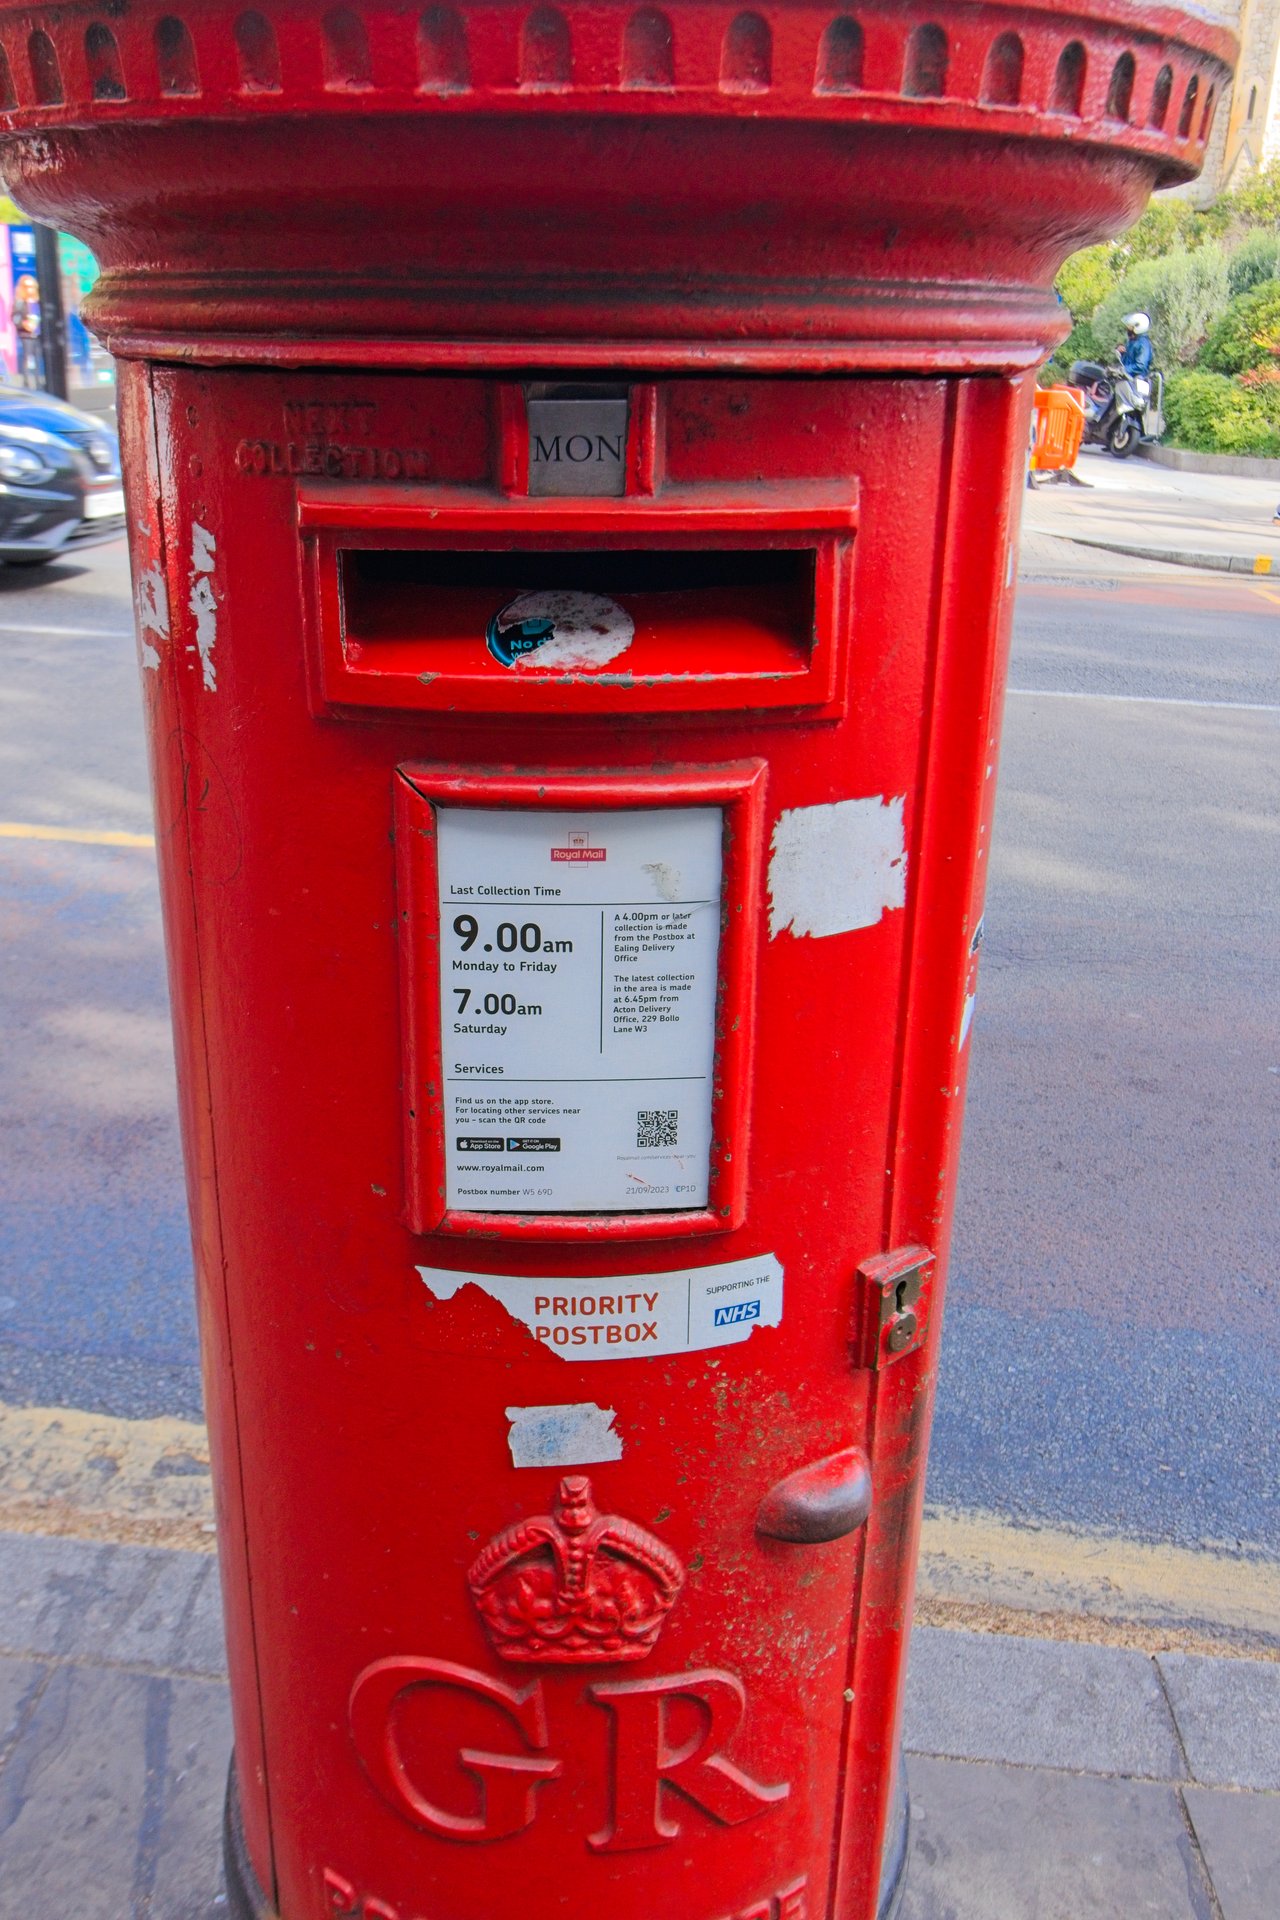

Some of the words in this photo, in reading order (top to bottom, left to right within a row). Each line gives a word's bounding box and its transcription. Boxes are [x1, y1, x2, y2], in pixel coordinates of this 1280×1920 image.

[533, 435, 622, 462] MON
[235, 439, 430, 477] COLLECTION
[510, 640, 533, 650] No
[553, 850, 580, 860] Royal
[582, 851, 603, 859] Mail
[450, 884, 474, 895] Last
[477, 885, 530, 896] Collection
[533, 886, 561, 896] Time
[622, 912, 658, 923] 4.00pm
[672, 912, 692, 921] later
[614, 923, 653, 932] collection
[655, 923, 663, 931] is
[665, 922, 688, 931] made
[452, 914, 573, 953] 9.00am
[614, 934, 634, 942] from
[636, 934, 650, 942] the
[652, 933, 685, 941] Postbox
[614, 944, 640, 953] Ealing
[642, 943, 675, 952] Delivery
[614, 954, 638, 963] Office
[452, 960, 499, 974] Monday
[502, 962, 515, 972] to
[520, 961, 557, 974] Friday
[657, 973, 695, 982] collection
[613, 985, 622, 993] in
[660, 984, 667, 992] is
[669, 983, 692, 991] made
[452, 988, 542, 1016] 7.00am
[613, 996, 622, 1004] at
[624, 994, 657, 1004] 6.45pm
[659, 994, 679, 1002] from
[638, 1005, 672, 1014] Delivery
[613, 1015, 639, 1024] Office,
[642, 1015, 657, 1023] 229
[659, 1014, 680, 1022] Bollo
[453, 1023, 507, 1036] Saturday
[634, 1025, 648, 1033] W3
[454, 1063, 504, 1074] Services
[455, 1096, 472, 1104] Find
[498, 1097, 512, 1105] the
[455, 1106, 469, 1114] For
[470, 1106, 502, 1116] locating
[504, 1107, 526, 1115] other
[527, 1107, 561, 1115] services
[455, 1117, 470, 1125] you
[498, 1116, 512, 1124] the
[514, 1116, 526, 1124] QR
[522, 1142, 545, 1150] Google
[545, 1142, 558, 1151] Play
[456, 1164, 545, 1173] www.royalmail.com
[490, 1188, 521, 1196] number
[625, 1185, 670, 1195] 21/09/2023
[706, 1279, 755, 1295] SUPPORTING
[756, 1275, 771, 1285] THE
[534, 1292, 659, 1316] PRIORITY
[716, 1302, 760, 1325] NHS
[536, 1321, 659, 1345] POSTBOX
